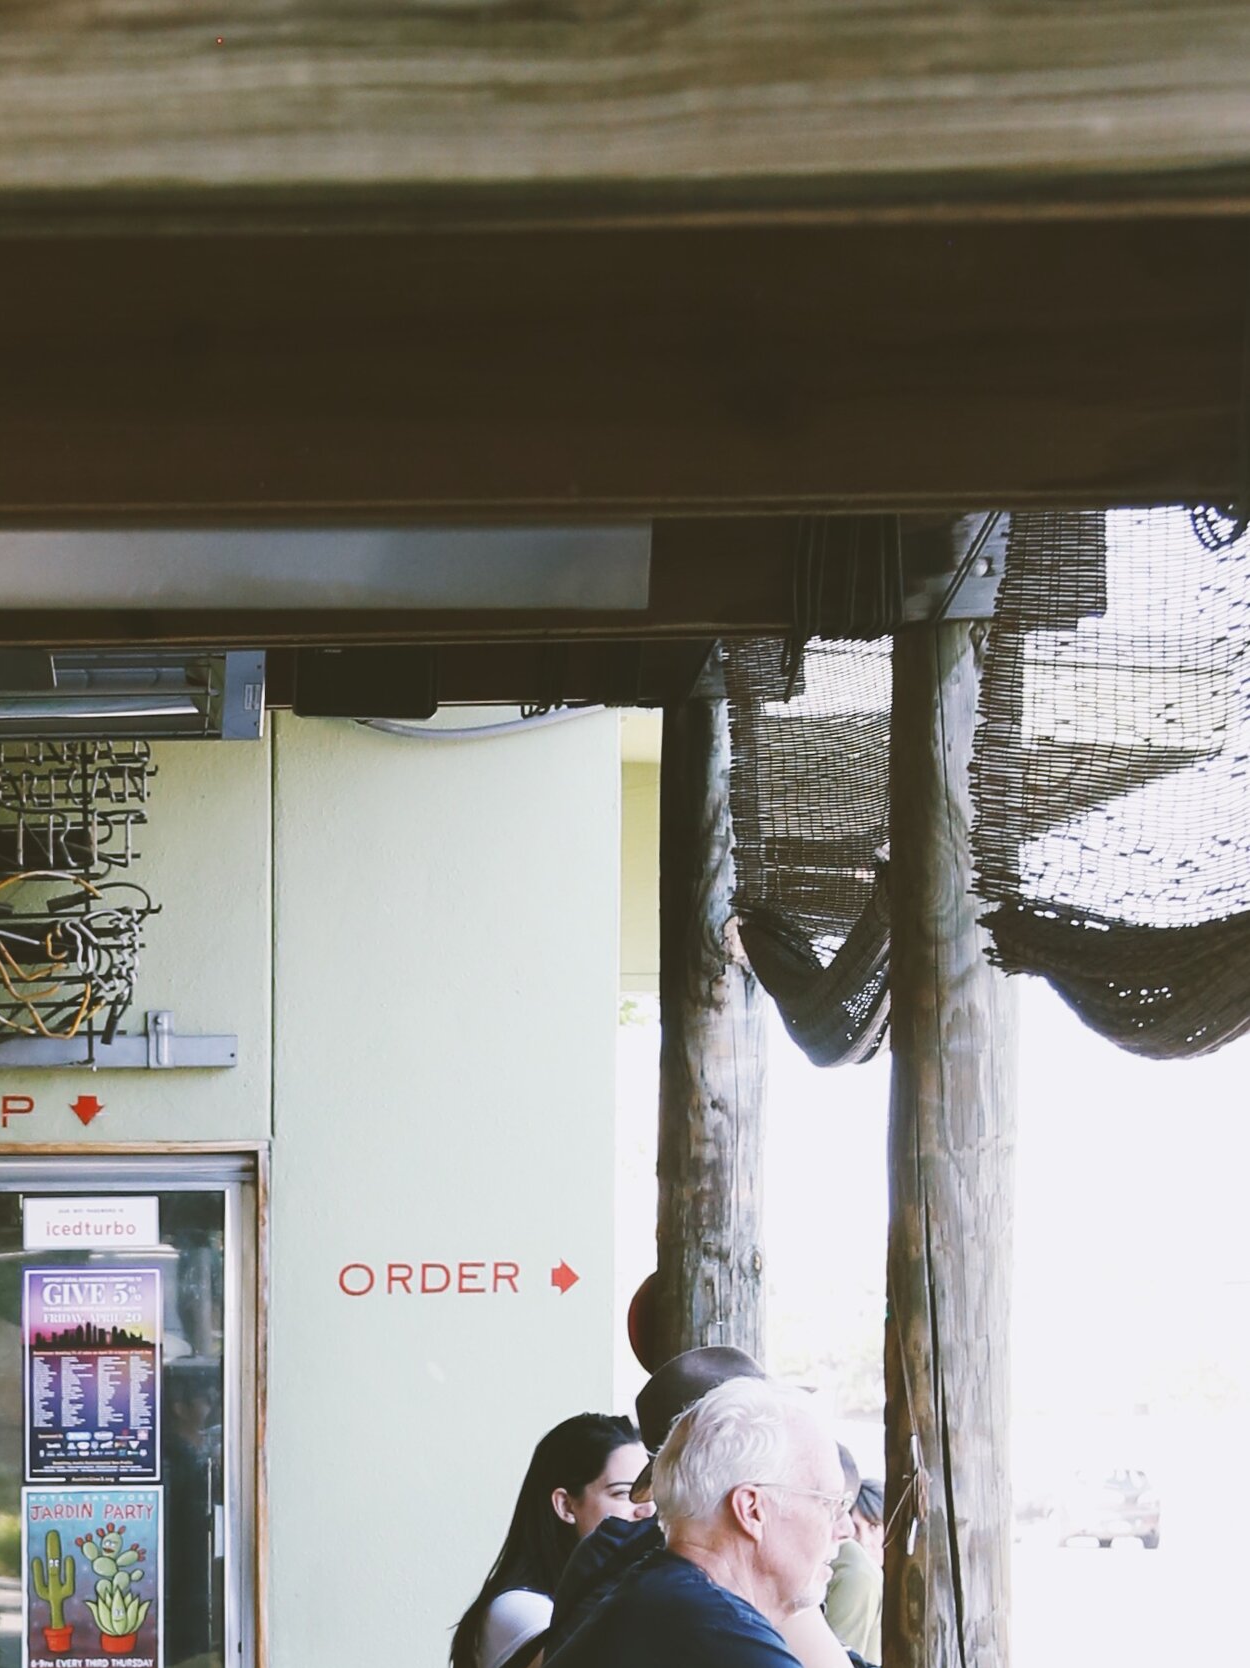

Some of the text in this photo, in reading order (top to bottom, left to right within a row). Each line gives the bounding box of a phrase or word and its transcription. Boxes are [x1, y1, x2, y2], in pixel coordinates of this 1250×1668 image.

[46, 1221, 136, 1236] icedturbo
[339, 1262, 519, 1296] ORDER
[42, 1283, 142, 1306] GIVE 5%
[43, 1311, 142, 1324] FRIDAY, APRIL 20
[83, 1494, 110, 1502] SAN
[30, 1503, 154, 1520] JARDIN PARTY
[56, 1658, 83, 1668] EVERY
[85, 1658, 109, 1668] THIRD
[111, 1658, 155, 1668] THURSDAY
